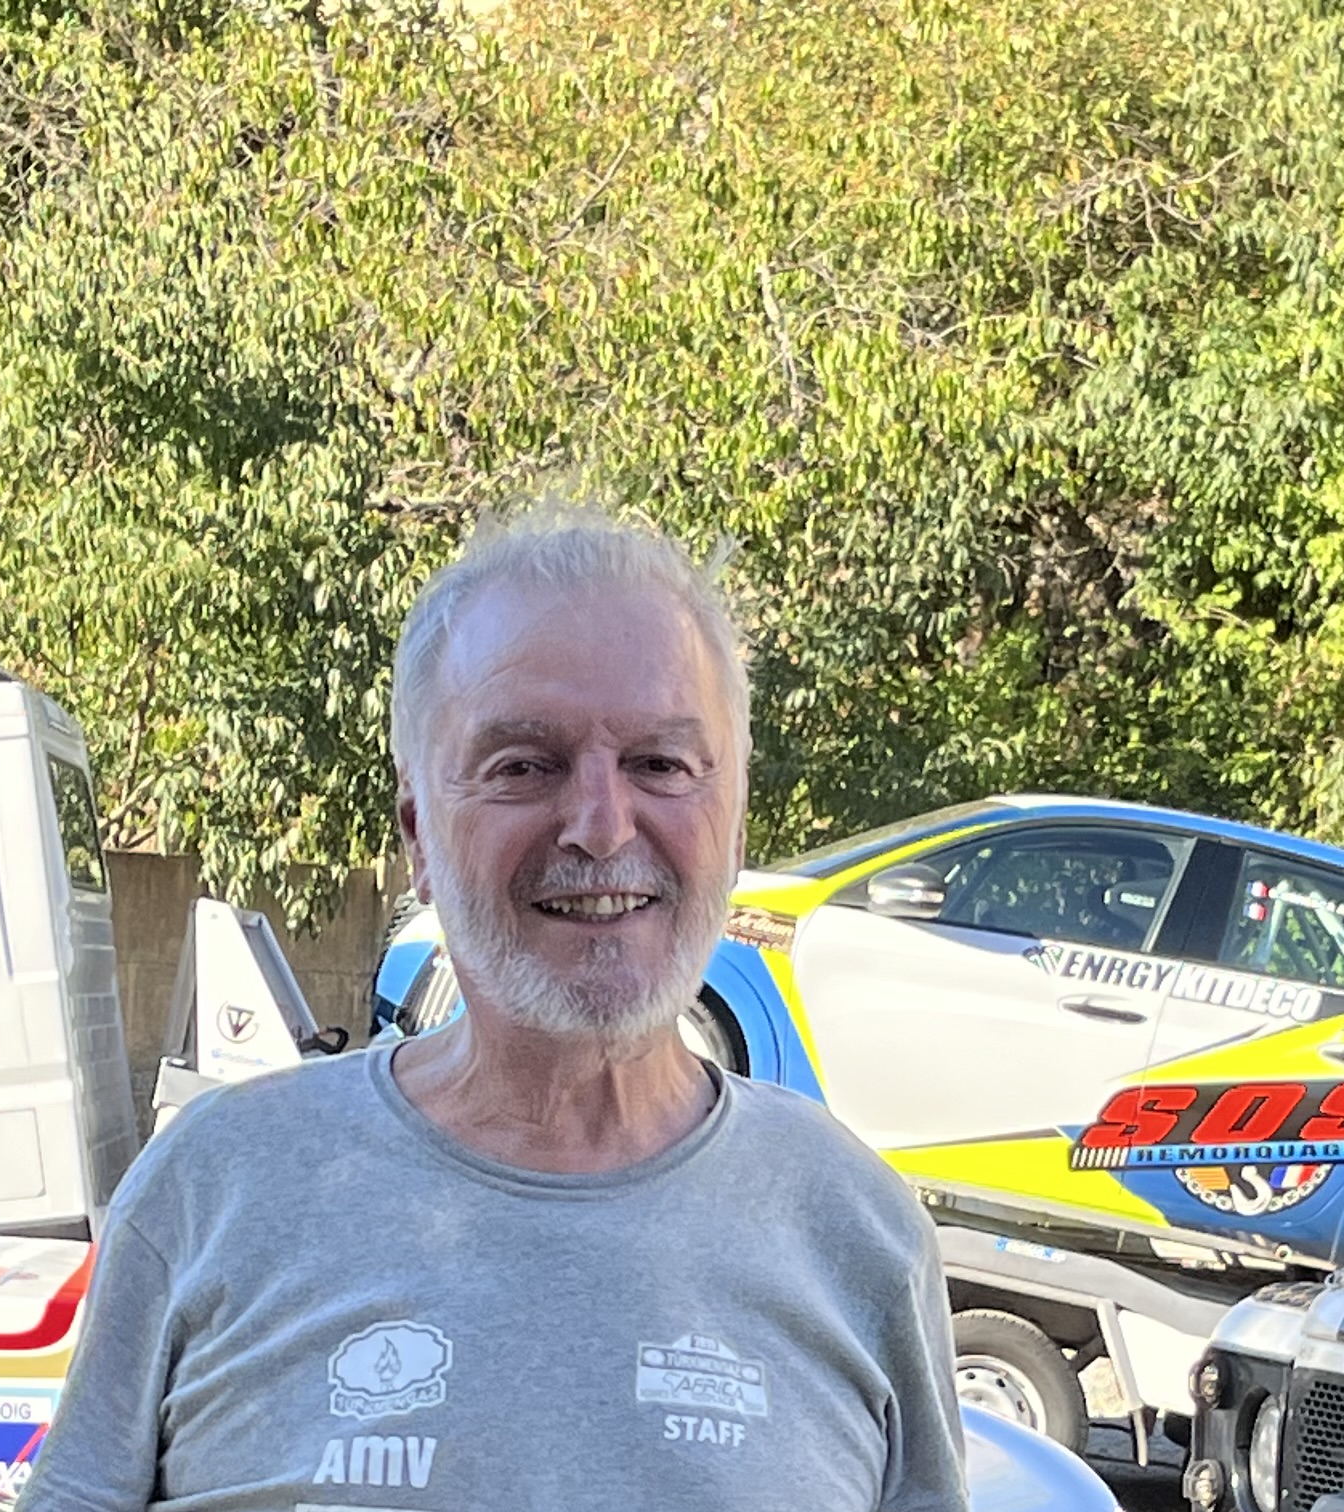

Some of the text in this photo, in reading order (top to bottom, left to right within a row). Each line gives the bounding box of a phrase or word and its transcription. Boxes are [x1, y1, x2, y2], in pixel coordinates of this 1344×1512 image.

[1060, 949, 1174, 991] ENRGY
[1172, 961, 1324, 1022] KITDECO
[663, 1414, 746, 1447] STAFF
